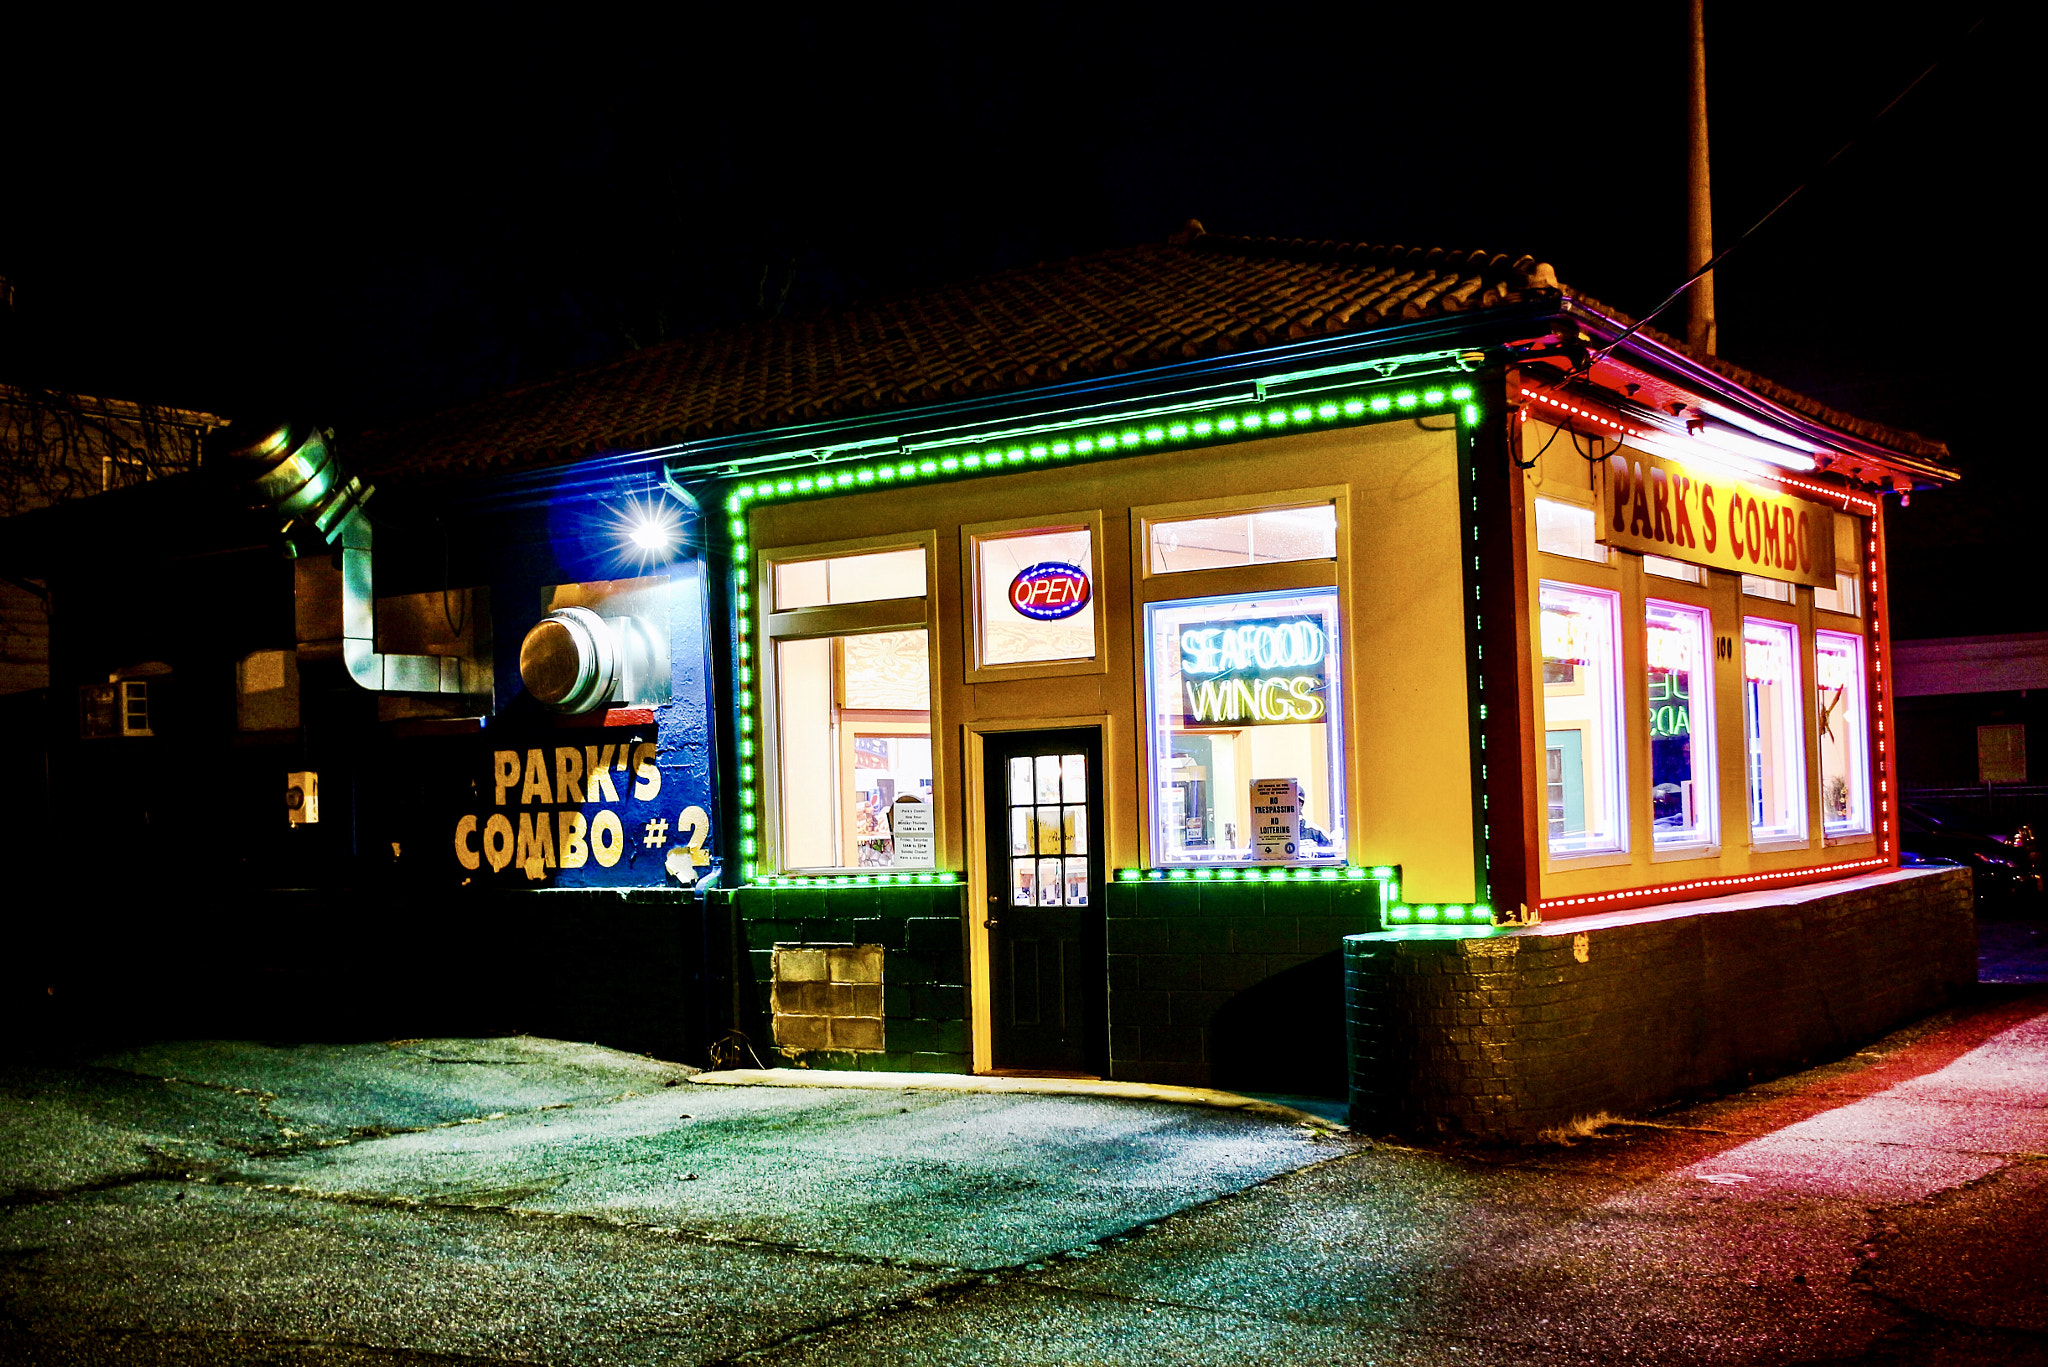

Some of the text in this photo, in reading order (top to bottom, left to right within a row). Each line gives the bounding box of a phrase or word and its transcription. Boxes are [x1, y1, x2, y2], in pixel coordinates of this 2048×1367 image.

[1610, 455, 1812, 575] PARK'S COMBO
[1014, 576, 1085, 607] OPEN
[1181, 620, 1326, 674] SEAFOOD
[1716, 636, 1733, 660] 100
[1185, 676, 1326, 722] WINGS
[494, 742, 662, 805] PARK'S
[1254, 805, 1295, 814] TRESPASSING
[1269, 796, 1279, 805] NO
[1259, 825, 1291, 835] LOITERING
[1270, 817, 1280, 826] NO
[454, 809, 624, 873] COMBO
